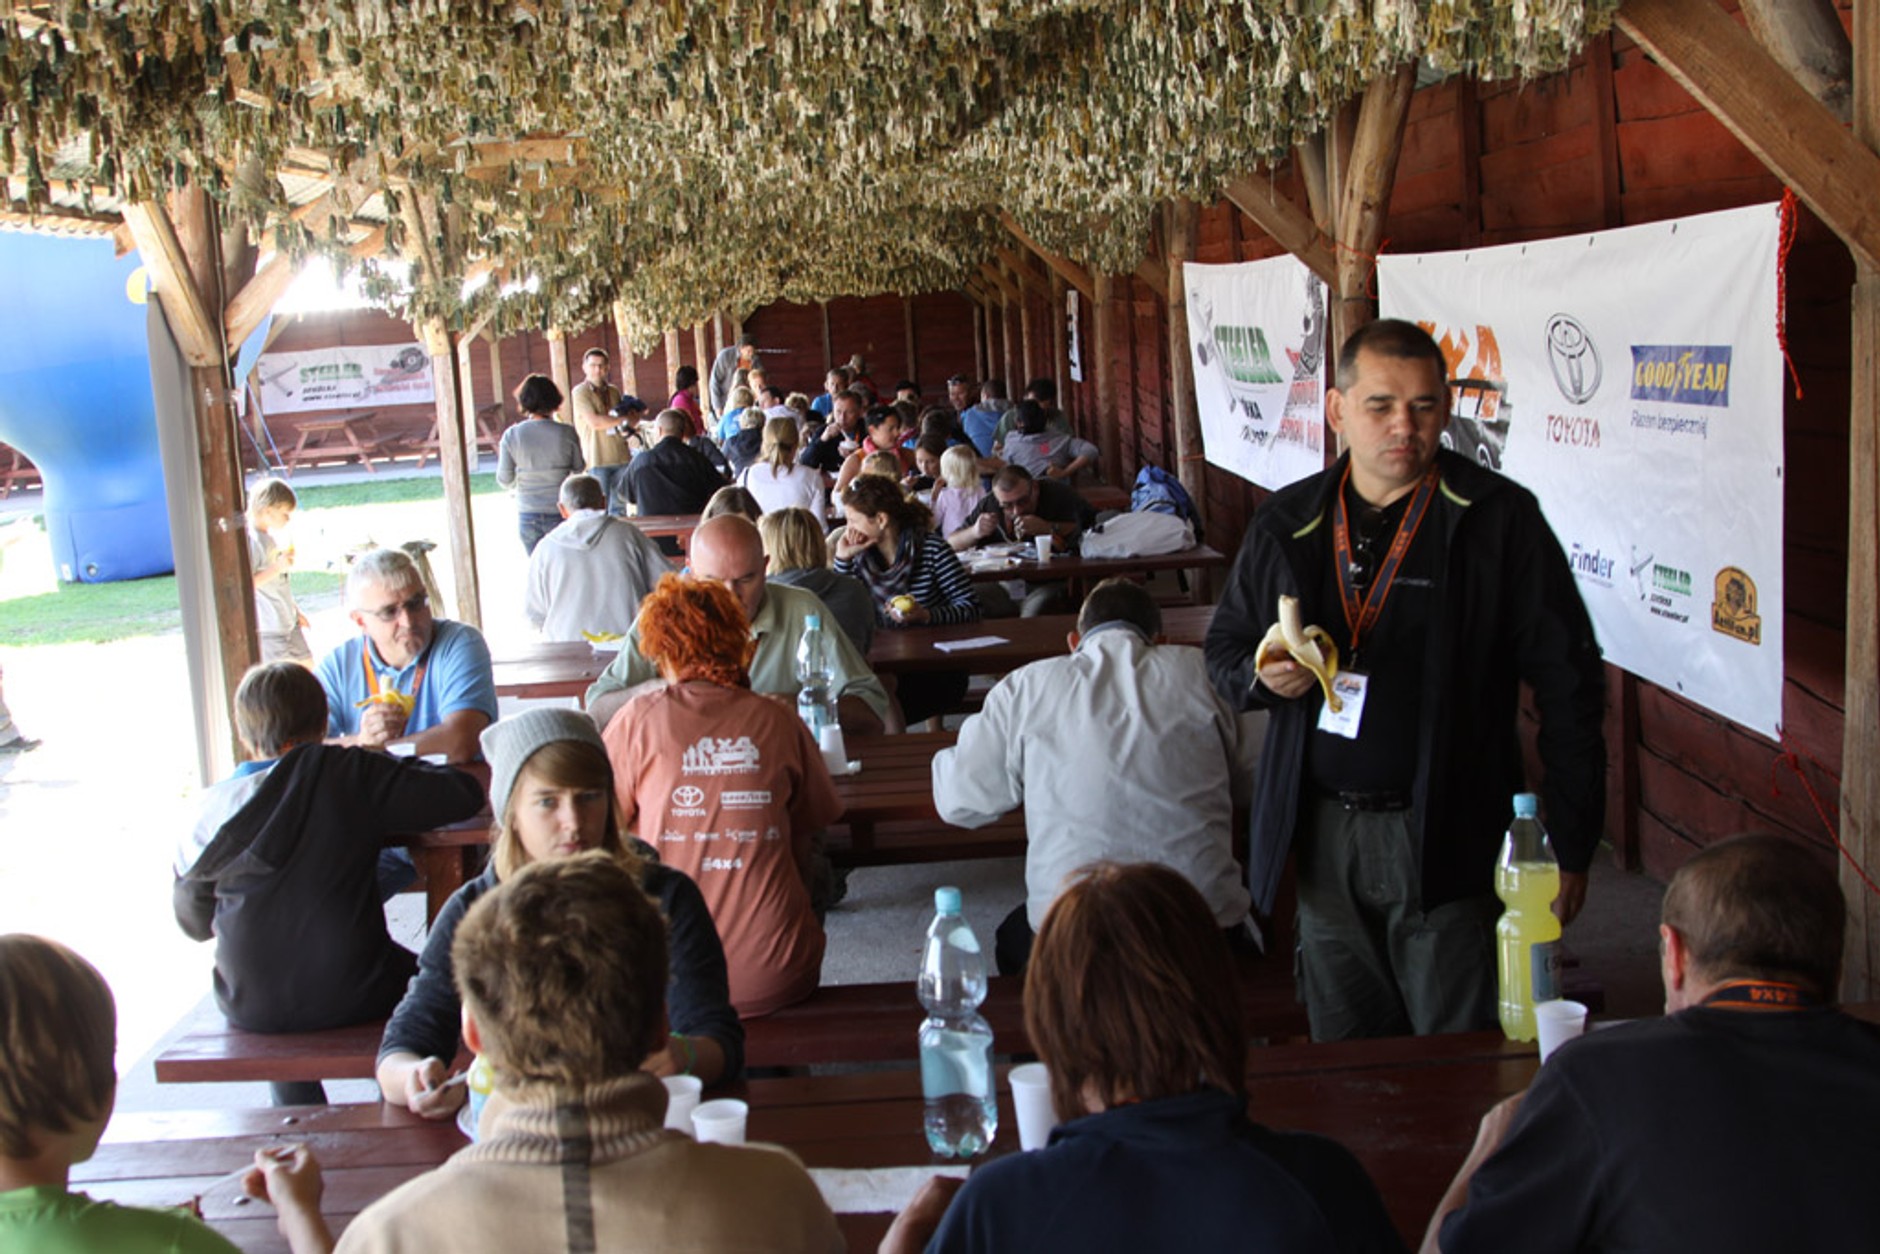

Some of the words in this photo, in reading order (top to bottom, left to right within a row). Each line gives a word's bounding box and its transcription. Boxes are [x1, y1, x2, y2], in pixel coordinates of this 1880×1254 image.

[1634, 353, 1728, 396] GOODYEAR
[1545, 413, 1602, 449] TOYOTA
[671, 807, 707, 817] TOYOTA
[711, 857, 743, 870] 4x4
